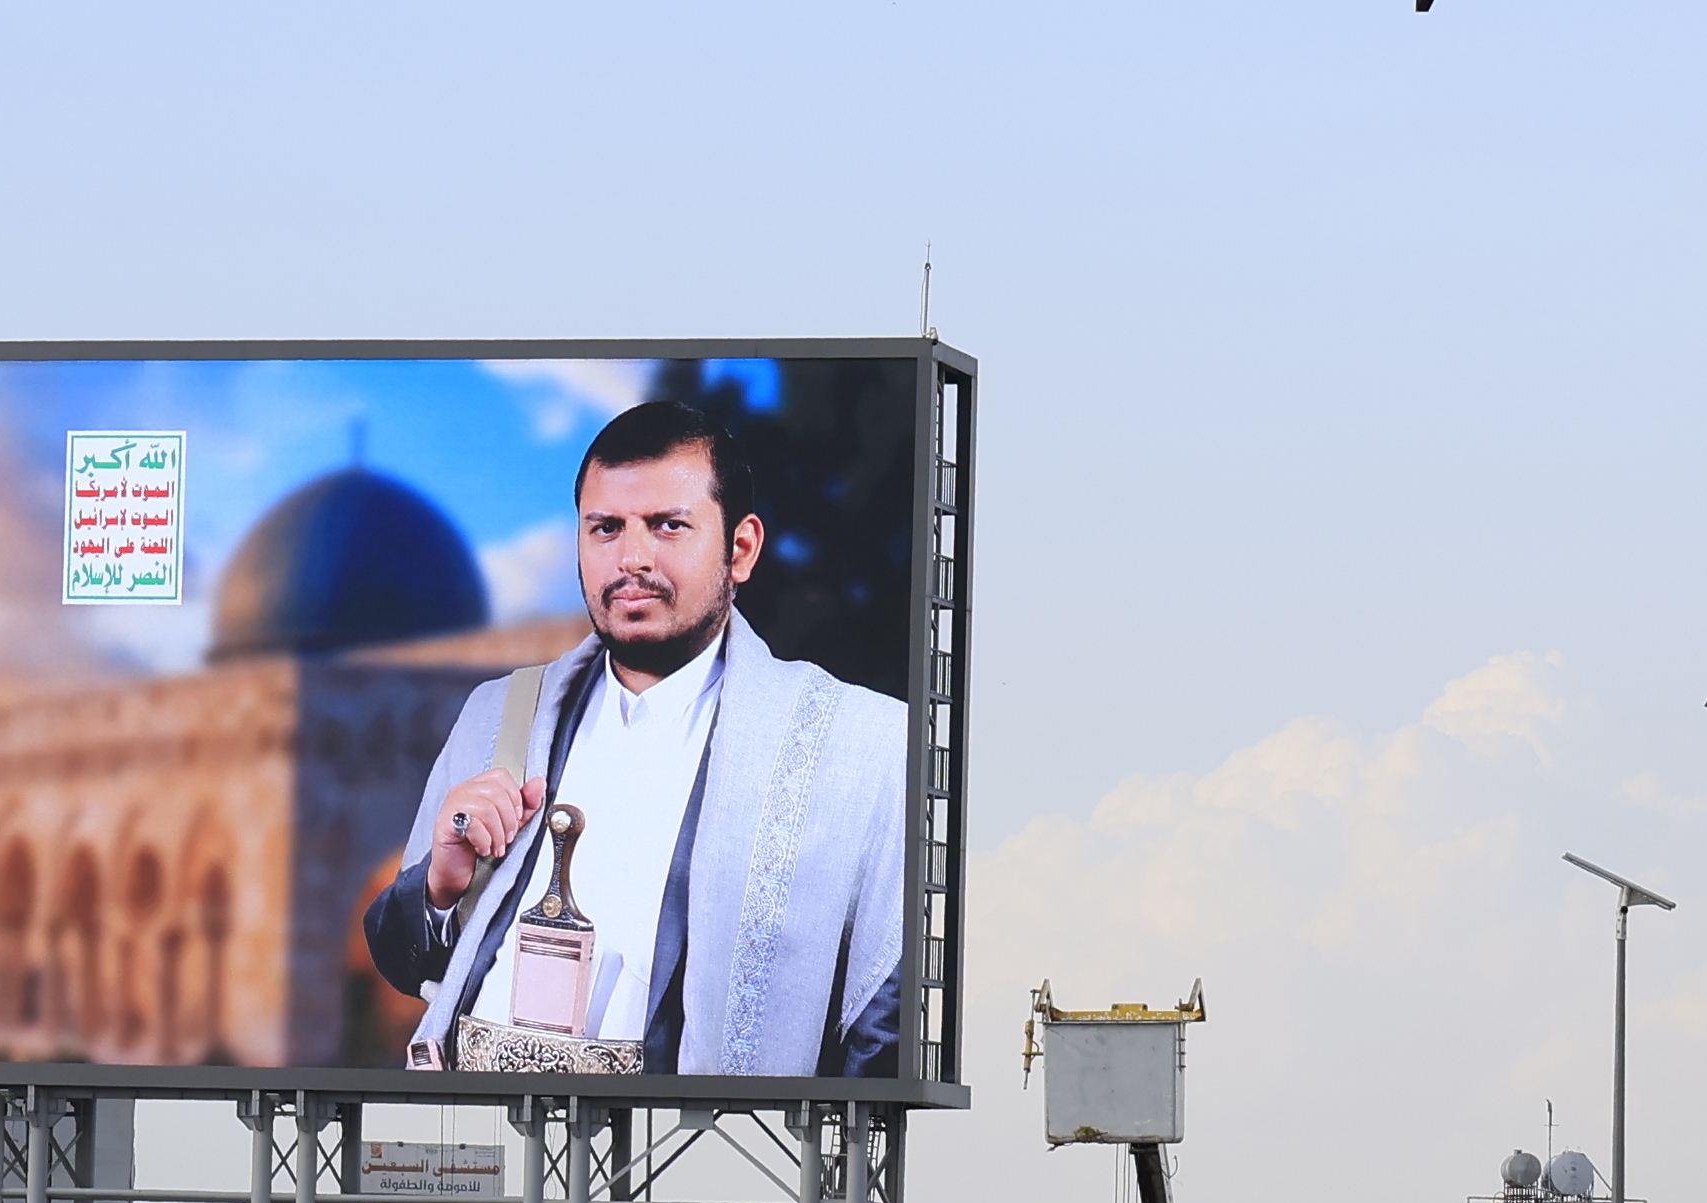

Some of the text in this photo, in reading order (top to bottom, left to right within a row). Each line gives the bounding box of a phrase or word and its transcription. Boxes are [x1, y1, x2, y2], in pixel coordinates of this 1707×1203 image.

[75, 439, 176, 478] الله أكبر
[75, 476, 175, 502] الموت لأمريكا
[74, 507, 174, 531] الموت لإسرائيل
[73, 536, 174, 558] اللعنة على اليهود
[72, 561, 172, 595] النصر للإسلام
[362, 1158, 501, 1177] مستشفى السبعين
[379, 1178, 481, 1195] للأمومة والطفولة
